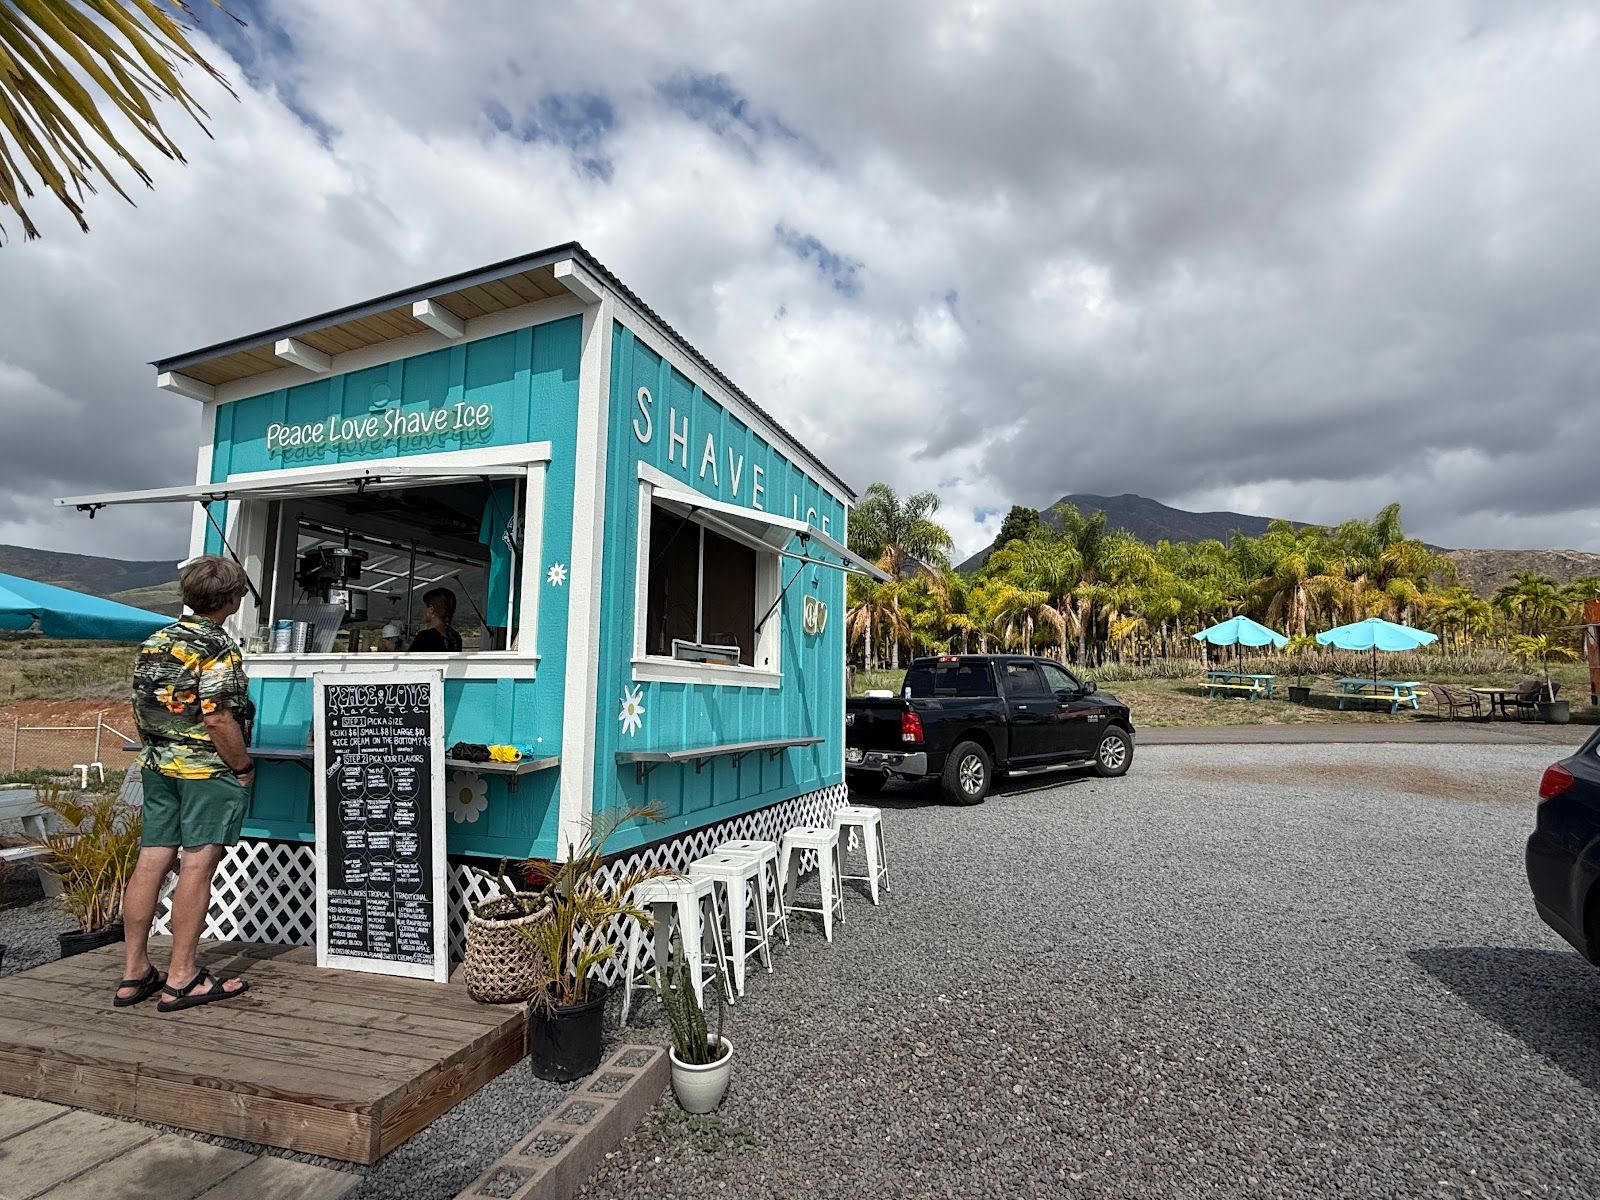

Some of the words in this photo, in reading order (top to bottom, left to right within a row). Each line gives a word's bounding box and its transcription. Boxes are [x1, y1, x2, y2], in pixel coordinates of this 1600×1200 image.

[267, 423, 324, 449] Peace
[329, 415, 379, 442] Love
[383, 407, 448, 438] Shave
[452, 401, 491, 430] Ice
[633, 386, 765, 511] SHAVE
[328, 685, 378, 708] PEACE
[385, 684, 431, 706] LOVE
[343, 718, 359, 726] STEP
[367, 717, 382, 725] PICK
[388, 717, 404, 725] SIZE
[330, 729, 347, 738] KEIKI
[348, 728, 358, 737] $6
[360, 728, 381, 736] SMALL
[381, 728, 390, 736] $8
[393, 728, 415, 737] LARGE
[415, 728, 426, 737] $10
[350, 738, 371, 746] CREAM
[373, 737, 382, 745] ON
[344, 755, 361, 764] STEP
[369, 755, 383, 763] PICK
[383, 755, 398, 763] YOUR
[398, 755, 425, 763] FLAVORS
[368, 890, 391, 898] TROPICAL
